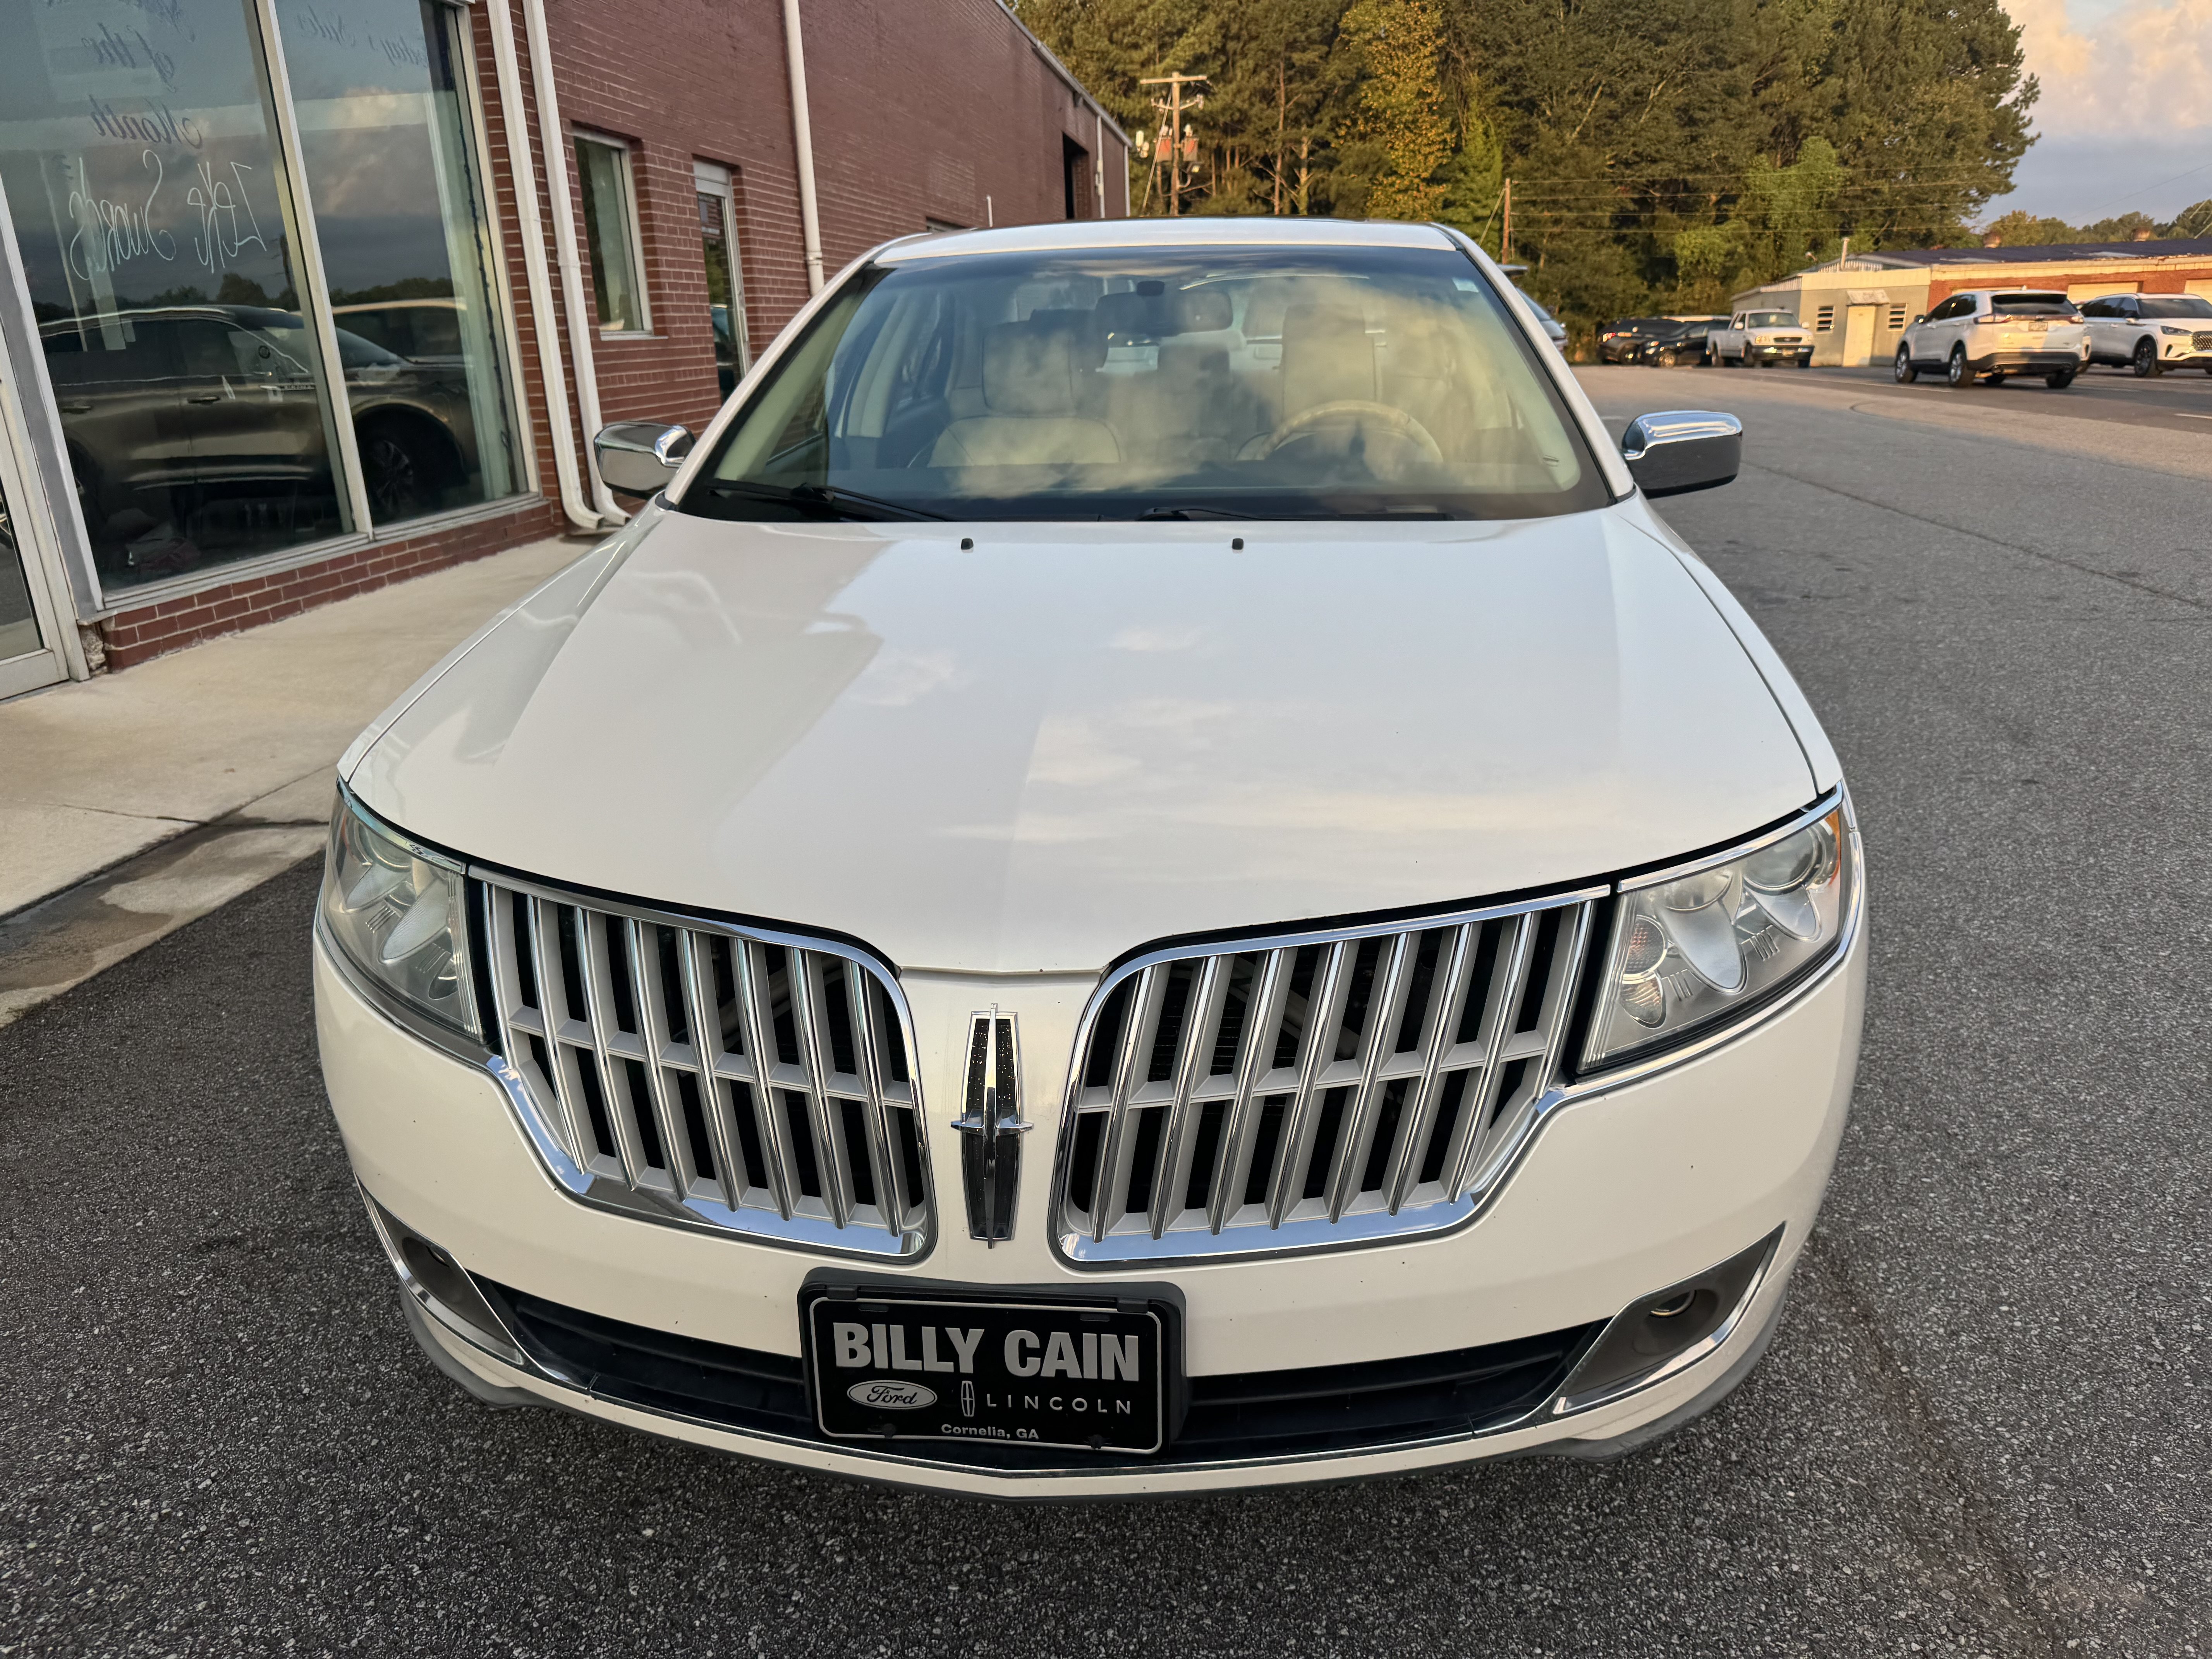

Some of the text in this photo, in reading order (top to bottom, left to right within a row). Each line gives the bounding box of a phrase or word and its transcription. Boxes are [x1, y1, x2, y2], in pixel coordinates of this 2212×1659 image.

[833, 1322, 1139, 1382] BILLY CAIN
[867, 1385, 918, 1405] Ford
[987, 1394, 1130, 1414] LINCOLN
[941, 1424, 1039, 1439] Cornelia, GA
